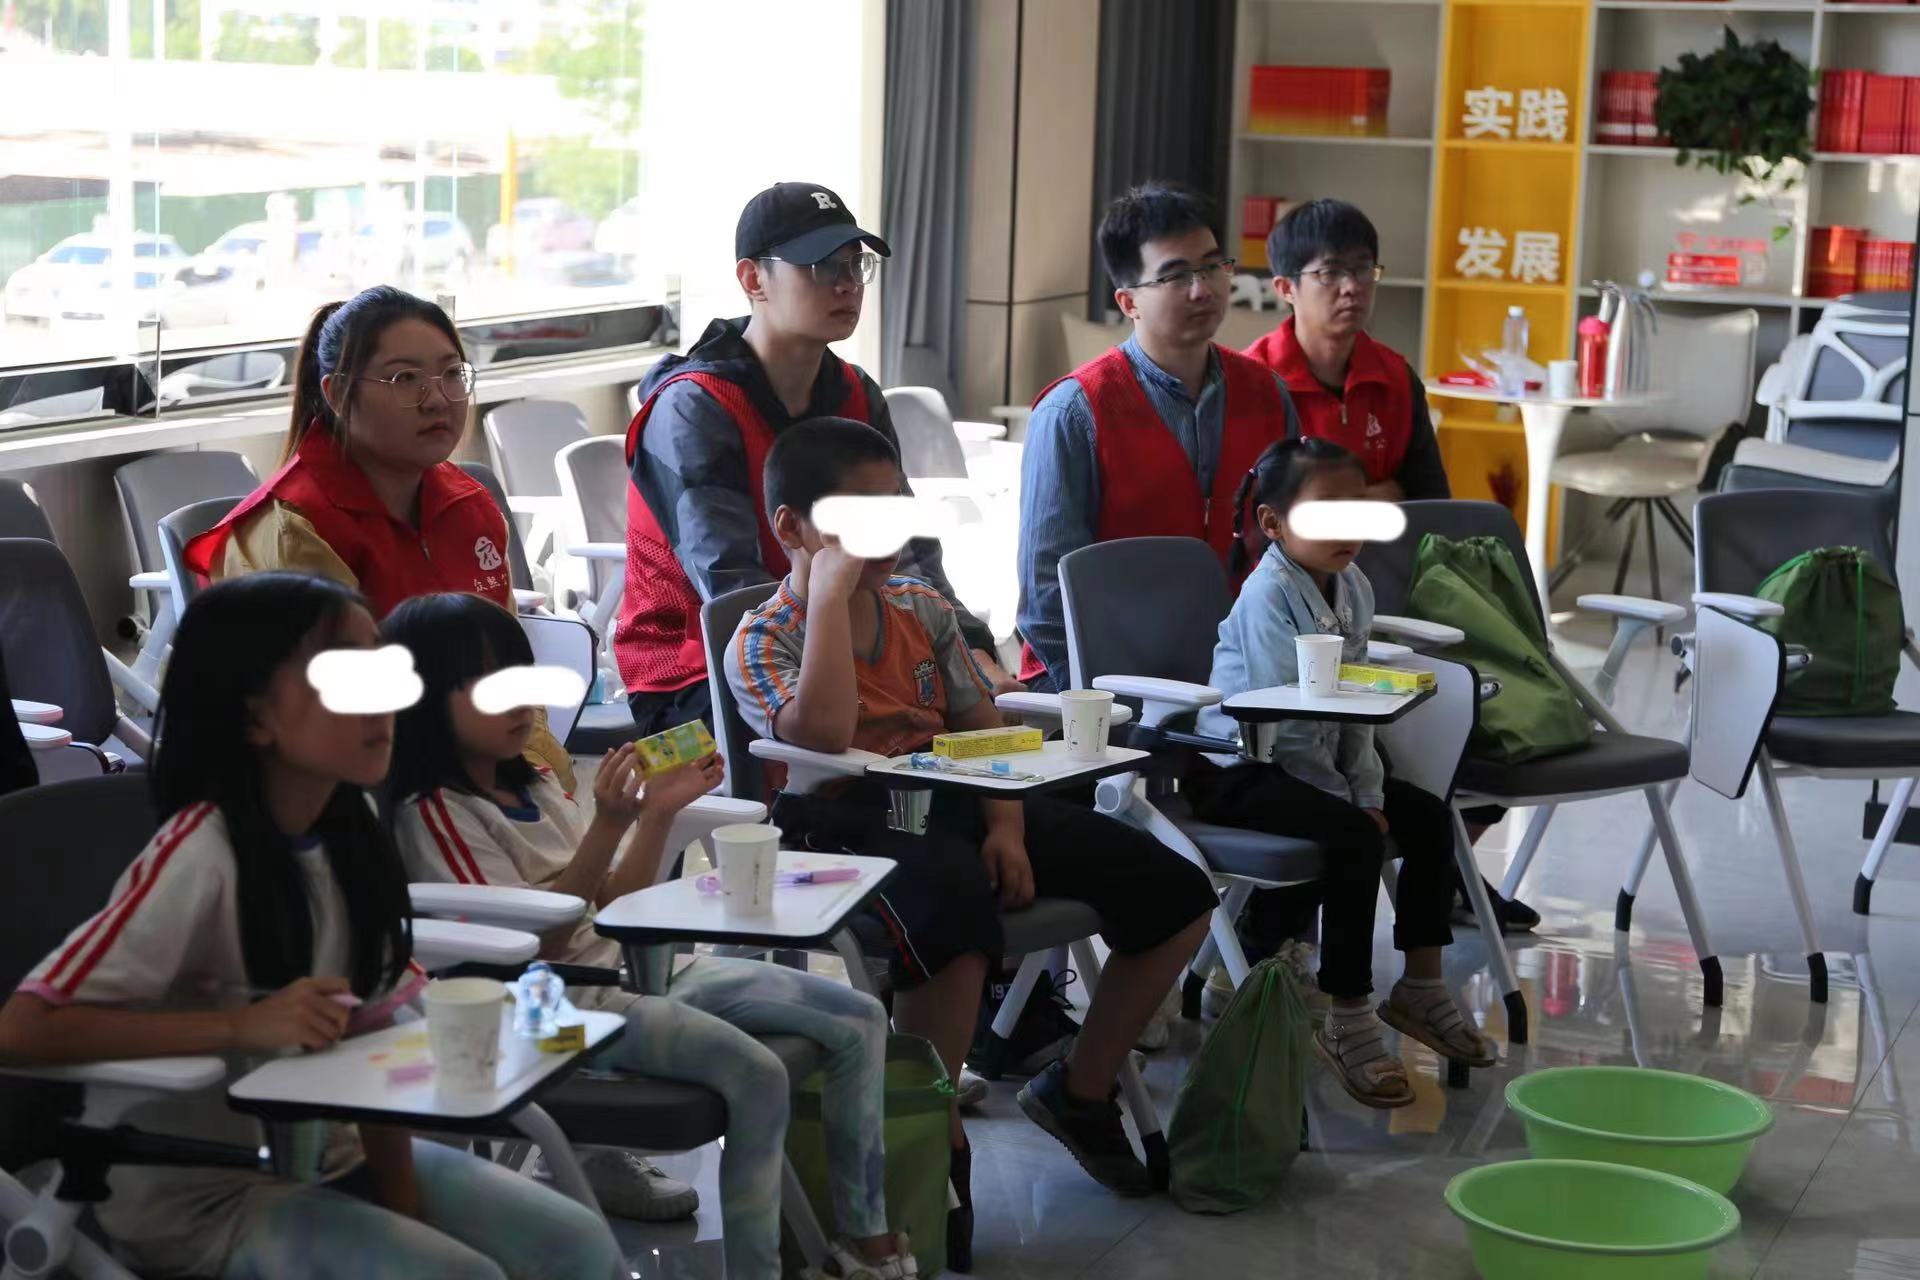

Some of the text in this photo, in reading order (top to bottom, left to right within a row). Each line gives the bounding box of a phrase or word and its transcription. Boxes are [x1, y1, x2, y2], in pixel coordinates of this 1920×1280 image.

[1462, 86, 1568, 143] 实践
[811, 192, 837, 209] R
[1455, 226, 1561, 284] 发展
